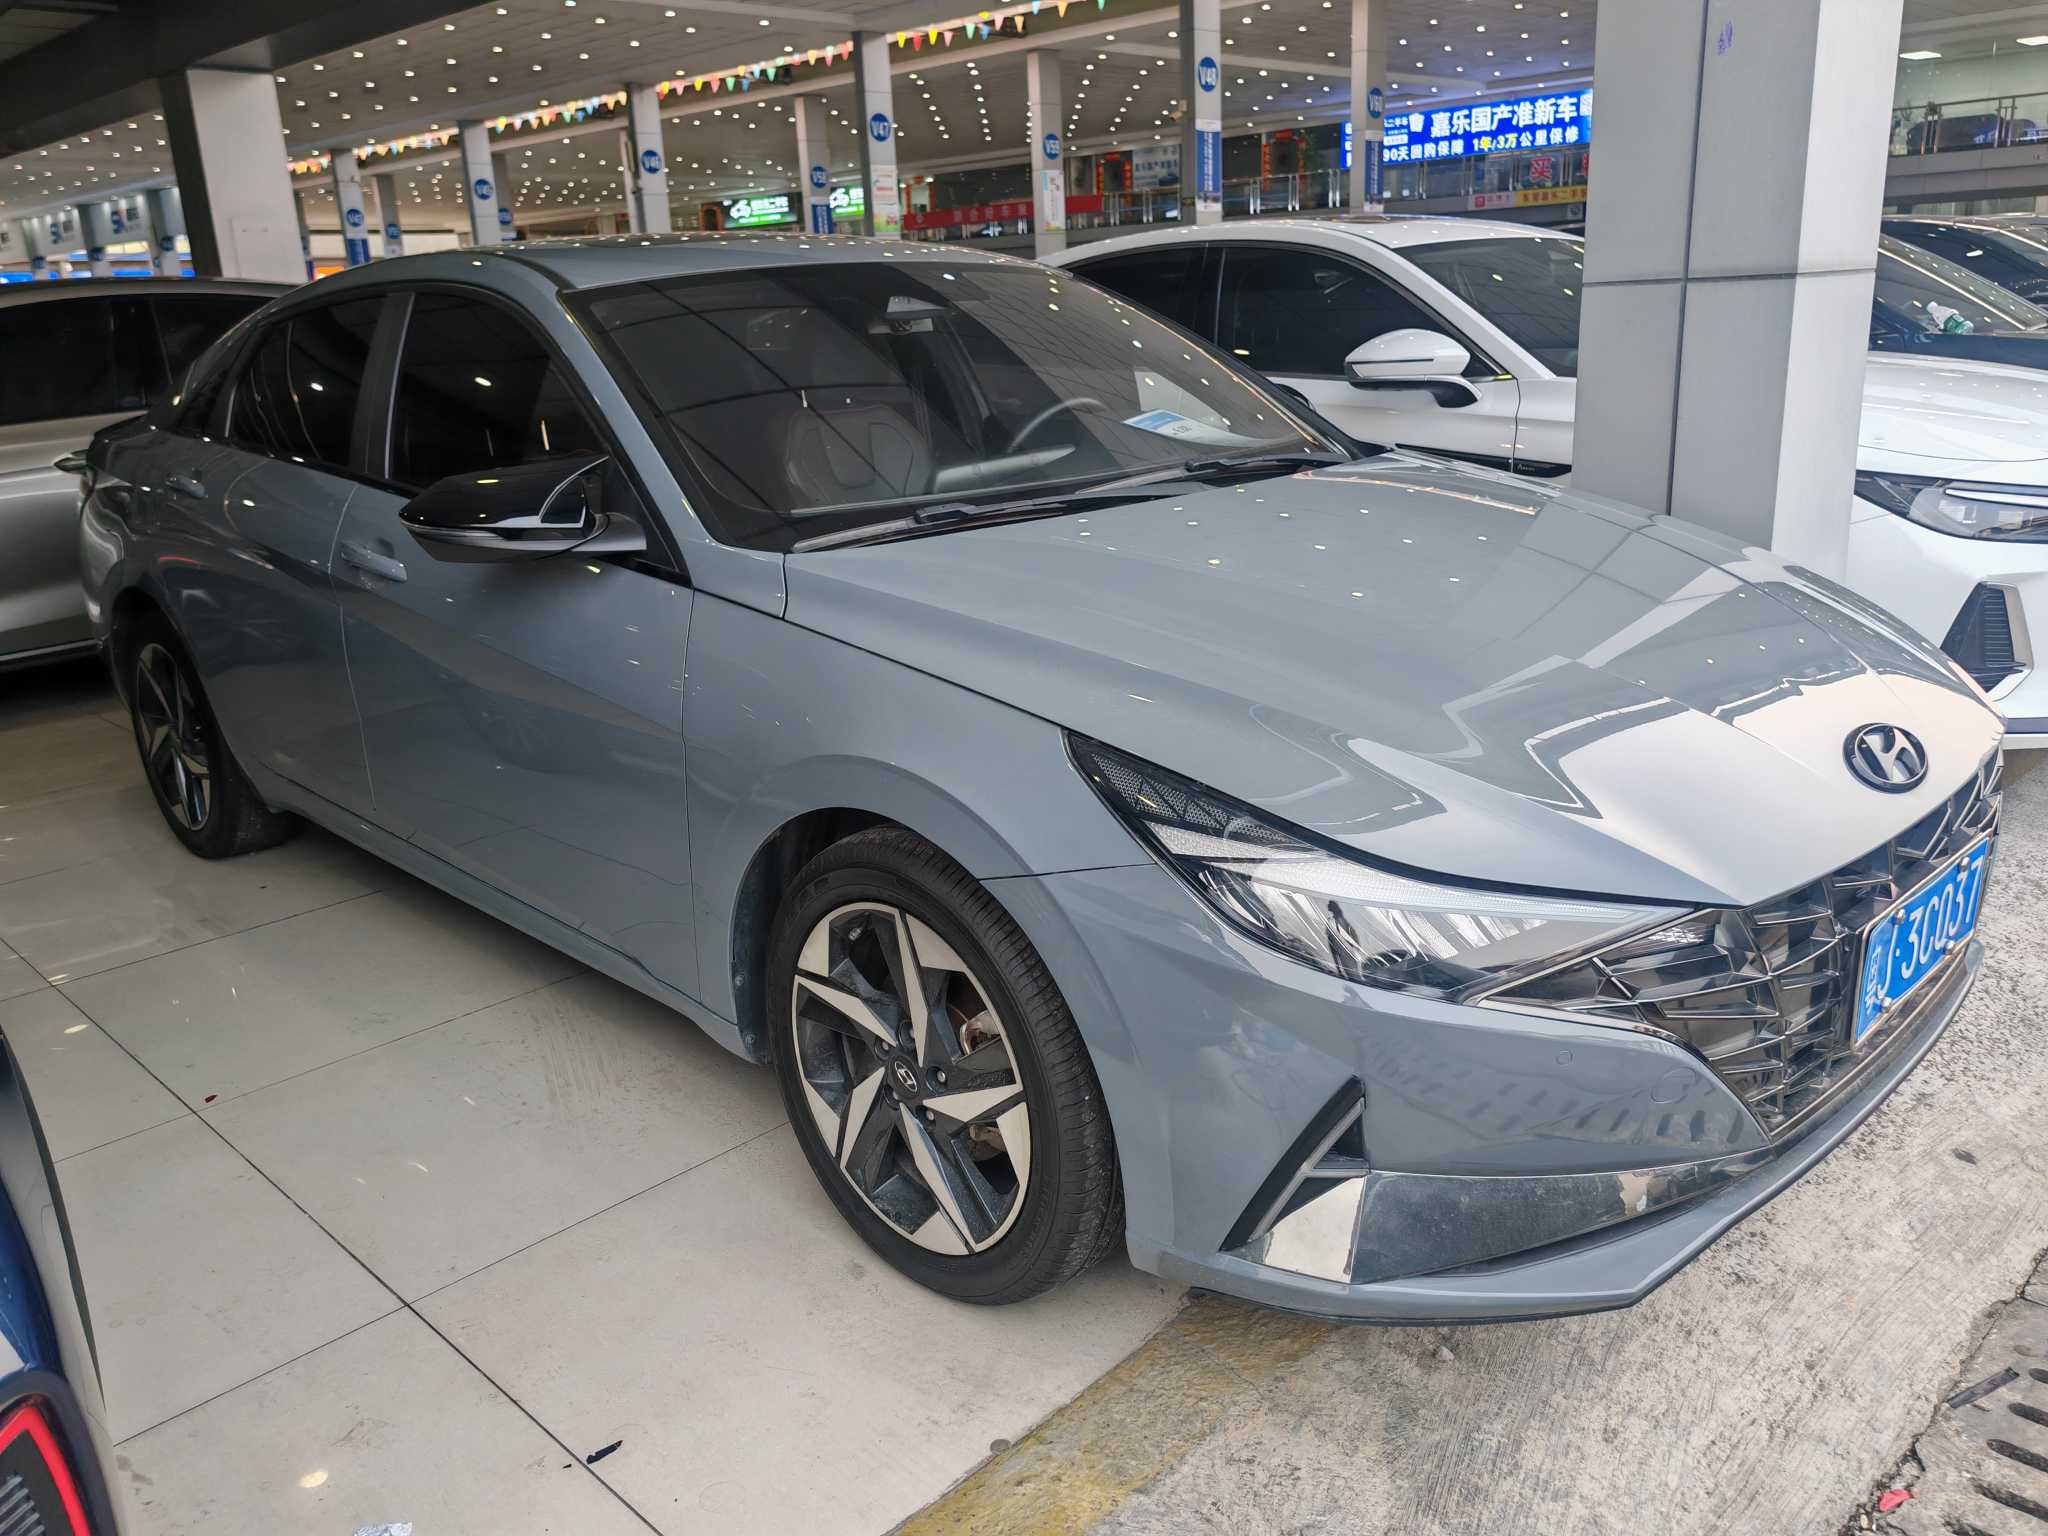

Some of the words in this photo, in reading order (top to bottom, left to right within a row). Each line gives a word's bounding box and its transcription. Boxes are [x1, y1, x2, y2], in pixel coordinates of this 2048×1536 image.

[1198, 65, 1217, 86] V48
[1383, 140, 1465, 162] 90天回购保障
